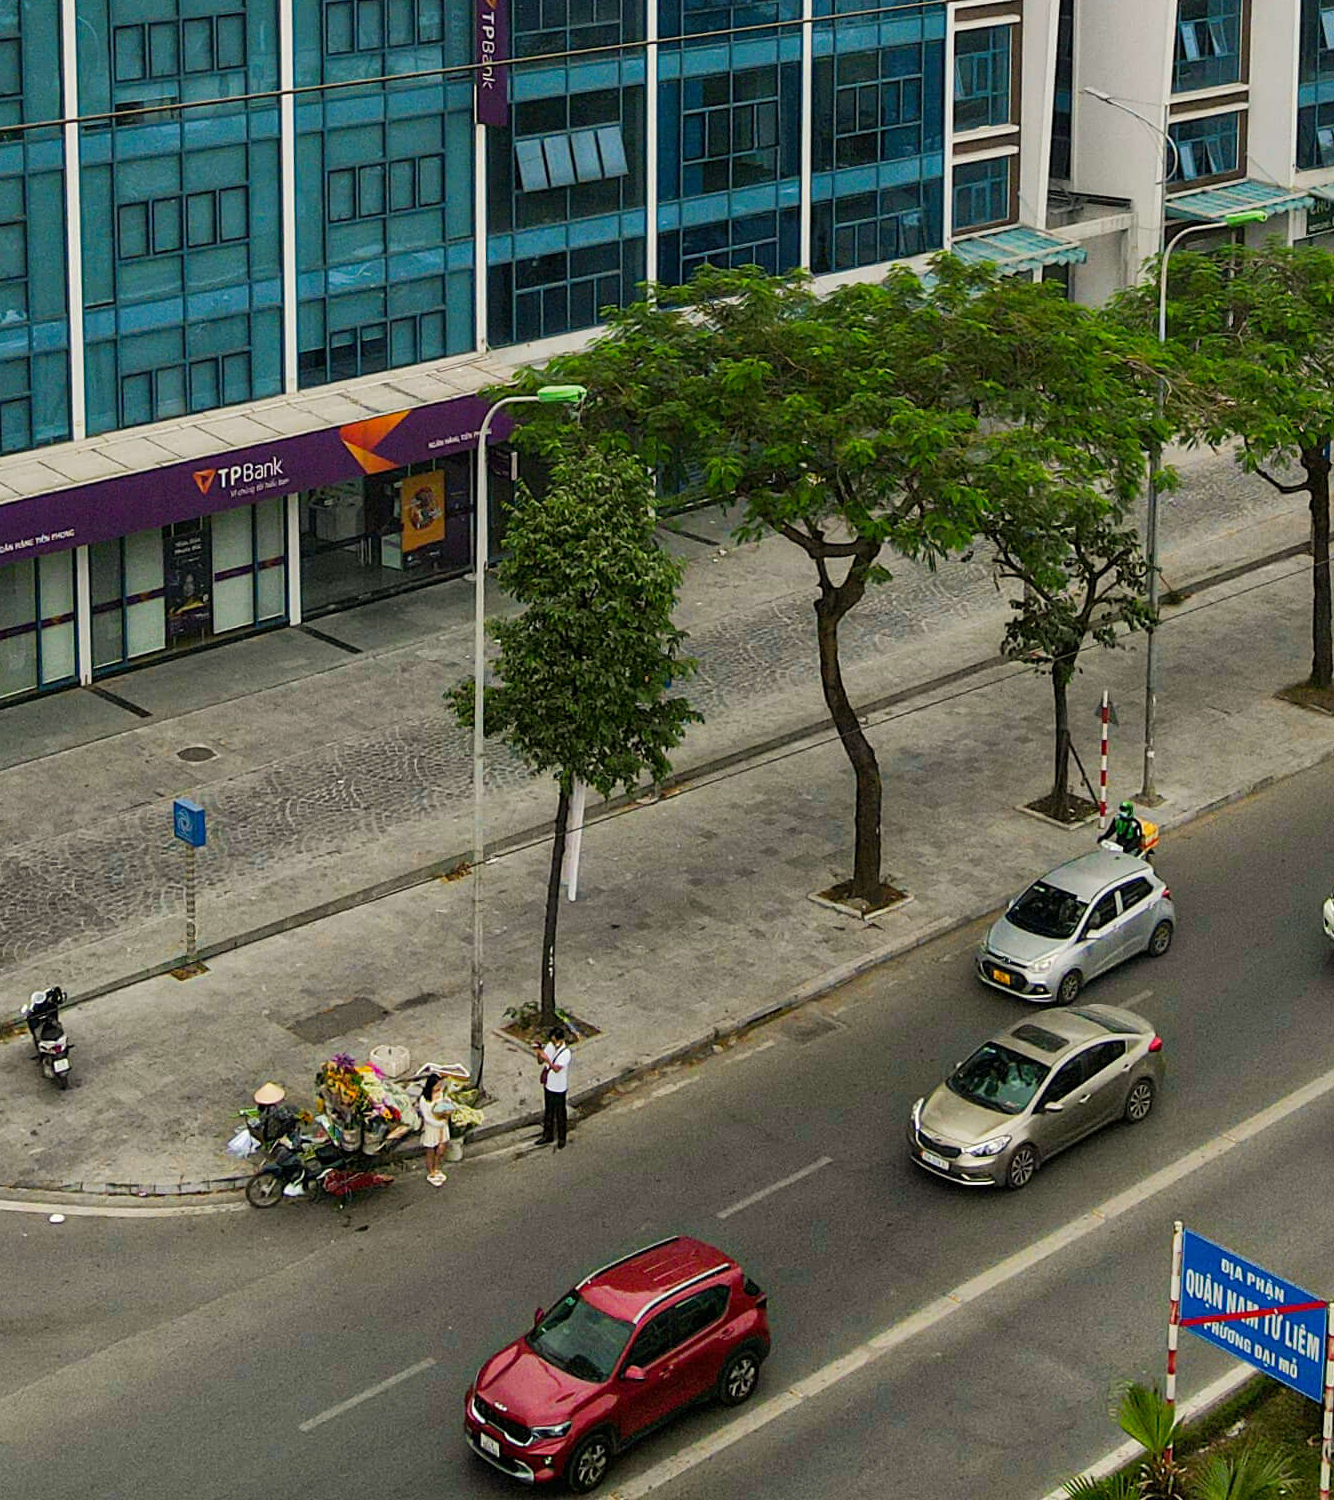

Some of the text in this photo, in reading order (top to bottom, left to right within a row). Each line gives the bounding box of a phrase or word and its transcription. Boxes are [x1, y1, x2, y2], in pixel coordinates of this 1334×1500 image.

[481, 11, 496, 90] TPBank
[217, 456, 284, 489] TPBank
[1186, 1268, 1223, 1309] QUẬN
[1285, 1320, 1320, 1363] LIÊM
